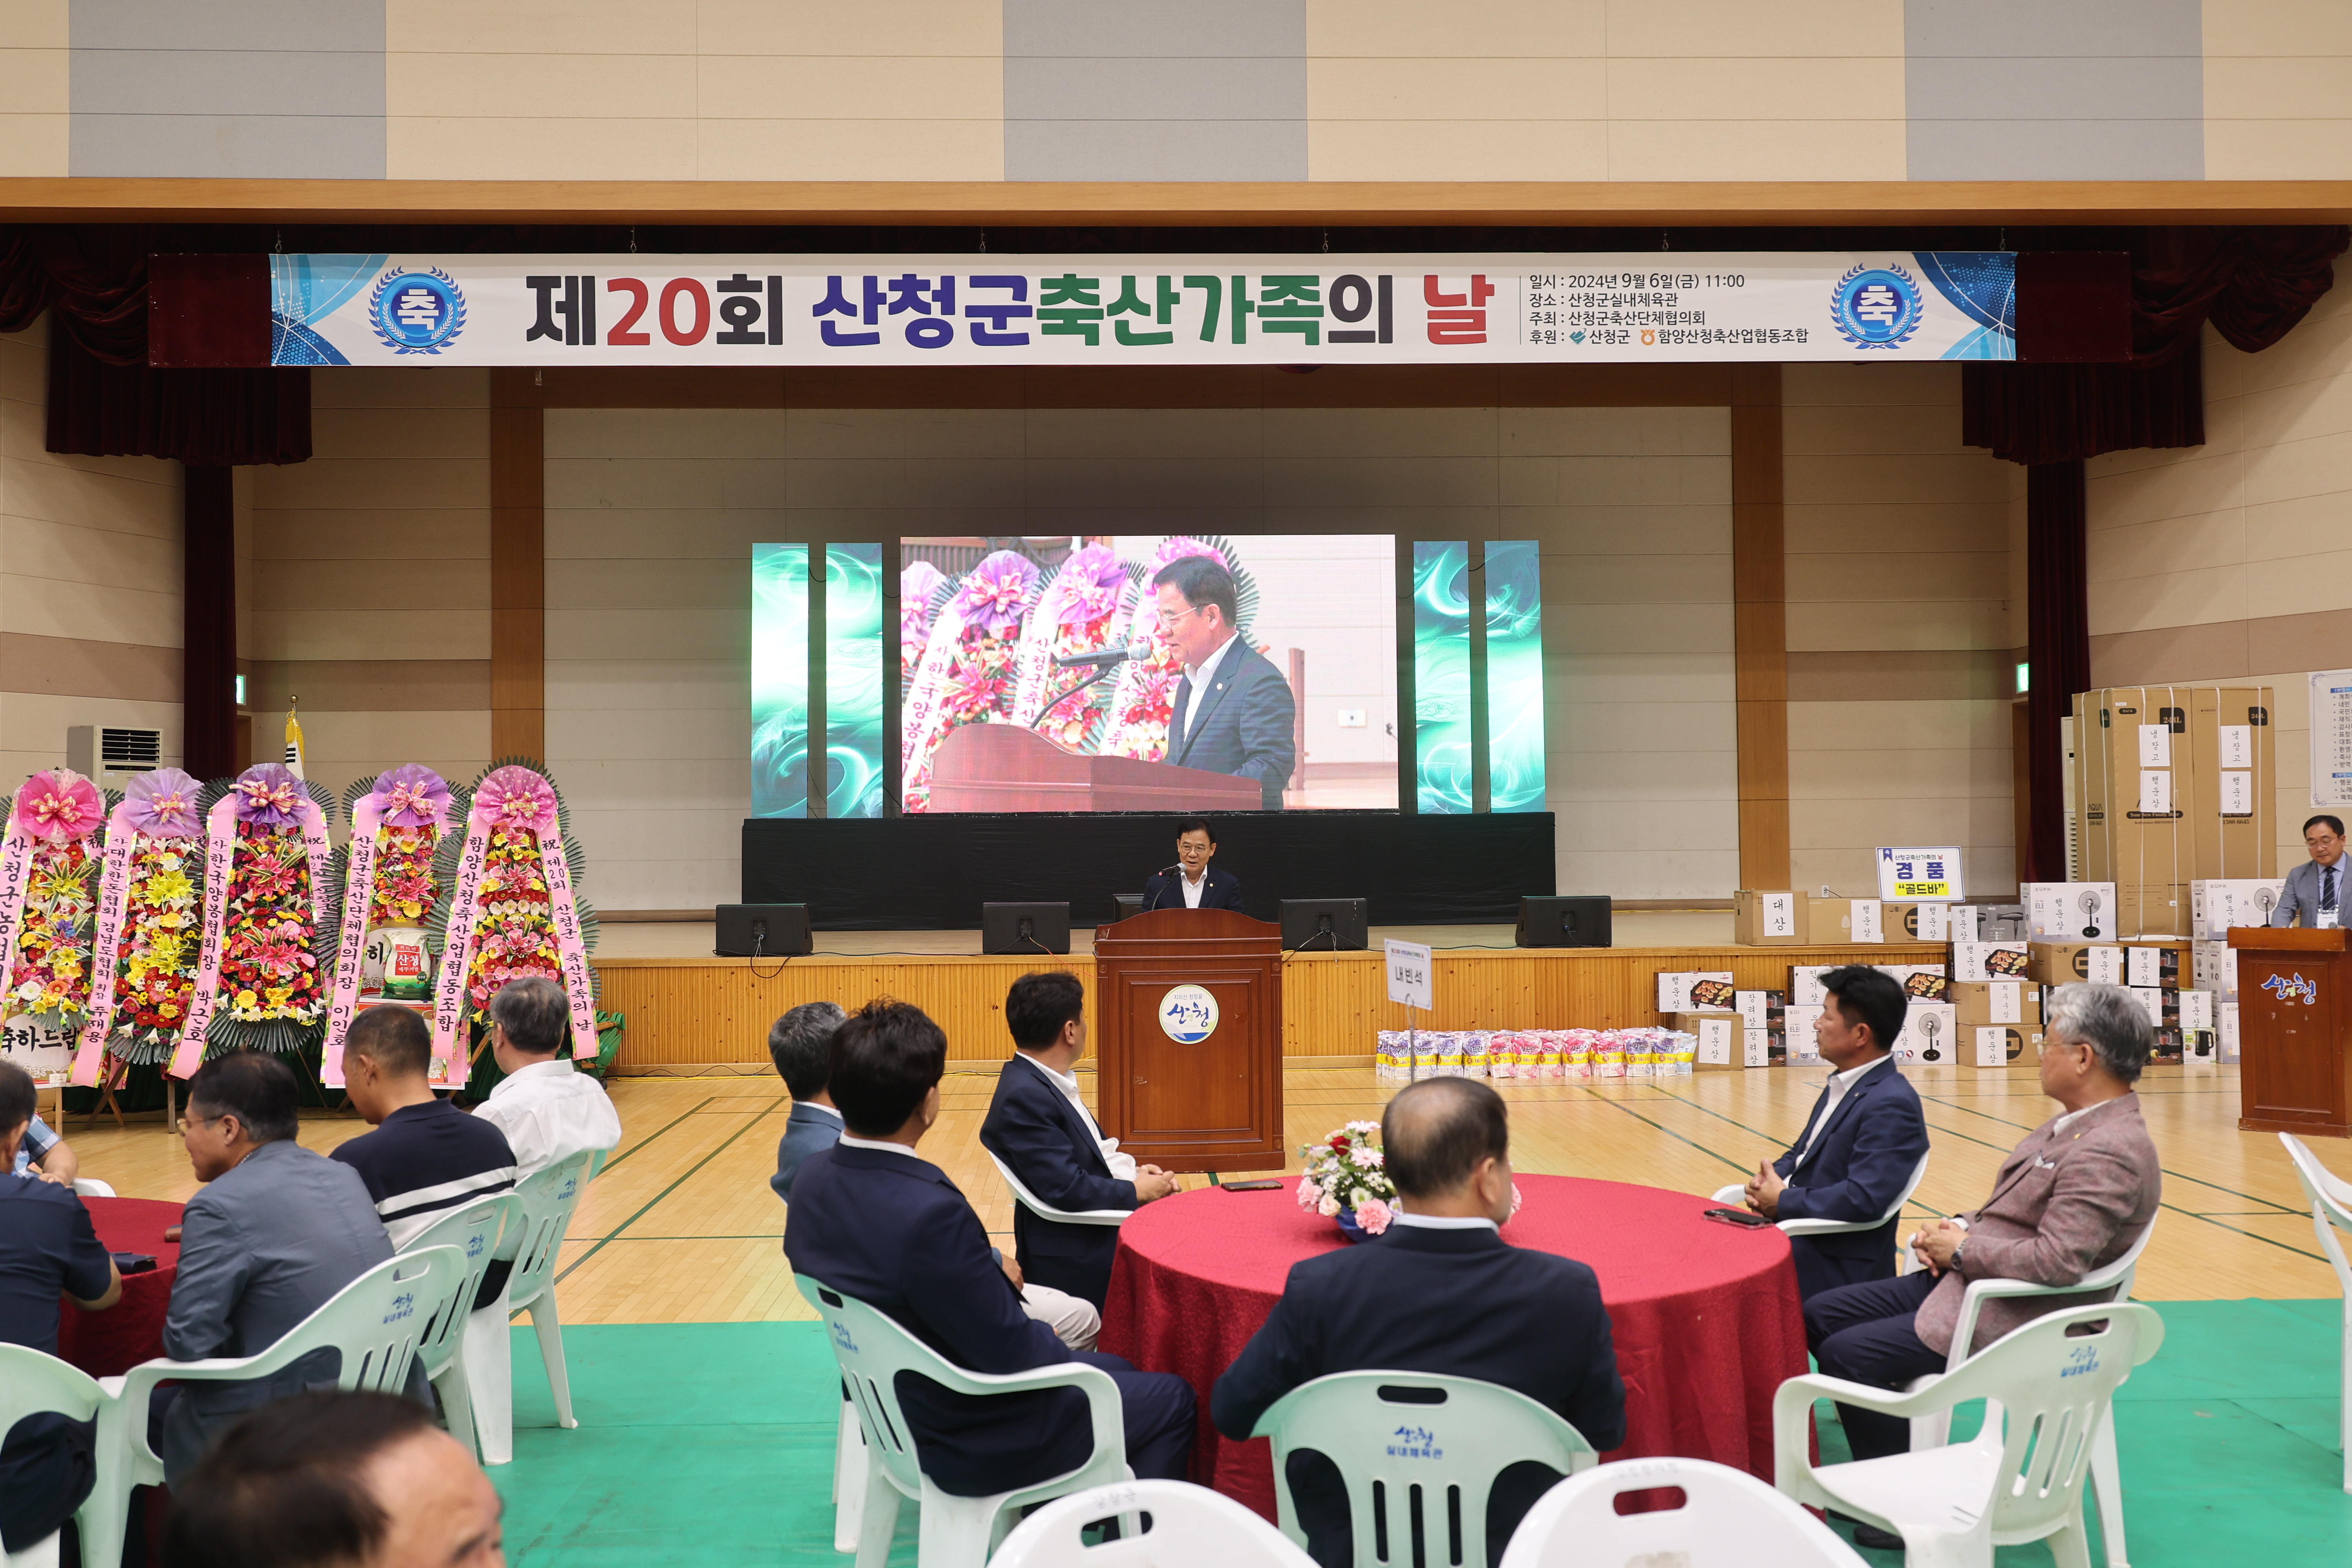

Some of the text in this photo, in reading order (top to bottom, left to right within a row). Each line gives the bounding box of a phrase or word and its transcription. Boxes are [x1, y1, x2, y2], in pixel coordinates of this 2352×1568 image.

[1530, 274, 1556, 289] 일시
[1568, 274, 1617, 289] 2024년
[1622, 273, 1646, 289] 9월
[1650, 273, 1700, 289] 6일(금)
[1706, 274, 1745, 287] 11:00
[397, 288, 439, 331] 축
[526, 274, 1495, 349] 제20회 산청군축산가족의 날
[1529, 293, 1557, 308] 장소
[1568, 292, 1678, 308] 산청군실내체육관
[1857, 285, 1897, 325] 축
[1529, 311, 1557, 326] 주최
[1568, 310, 1706, 326] 산청군축산단체협의회
[1529, 329, 1557, 344] 후원
[1589, 329, 1631, 345] 산청군
[1658, 328, 1809, 344] 함양산청축산업협동조합
[2150, 729, 2160, 761] 냉장고
[2232, 730, 2241, 762] 냉장고
[2151, 775, 2160, 808] 행운상
[2232, 776, 2241, 809] 행운상
[541, 839, 560, 851] 祝
[337, 835, 373, 989] 산청군축산단체협의회장
[555, 904, 577, 939] 산청군
[1773, 898, 1786, 931] 대상
[1862, 905, 1871, 937] 행운상
[1929, 906, 1937, 938] 행운상
[1959, 908, 1968, 941] 행운상
[2055, 897, 2064, 930] 행운상
[2225, 894, 2235, 927] 행운상
[437, 836, 485, 1032] 함양산청축산업협동조합
[397, 954, 419, 966] 산청
[1395, 965, 1423, 987] 내빈석
[1966, 945, 1975, 978] 행운상
[2100, 949, 2109, 983] 행운상
[2140, 950, 2149, 984] 행운상
[565, 952, 588, 1012] 축산가족의
[1671, 975, 1681, 1009] 행운상
[1809, 969, 1819, 1003] 인기상
[183, 989, 212, 1042] 박근호
[575, 1019, 592, 1031] 날
[1748, 993, 1757, 1027] 장려상
[2192, 994, 2201, 1028] 행운상
[2, 1025, 80, 1053] 축하드립
[1711, 1025, 1720, 1059] 행운상
[1749, 1031, 1758, 1065] 장려상
[1987, 1029, 1997, 1063] 행운상
